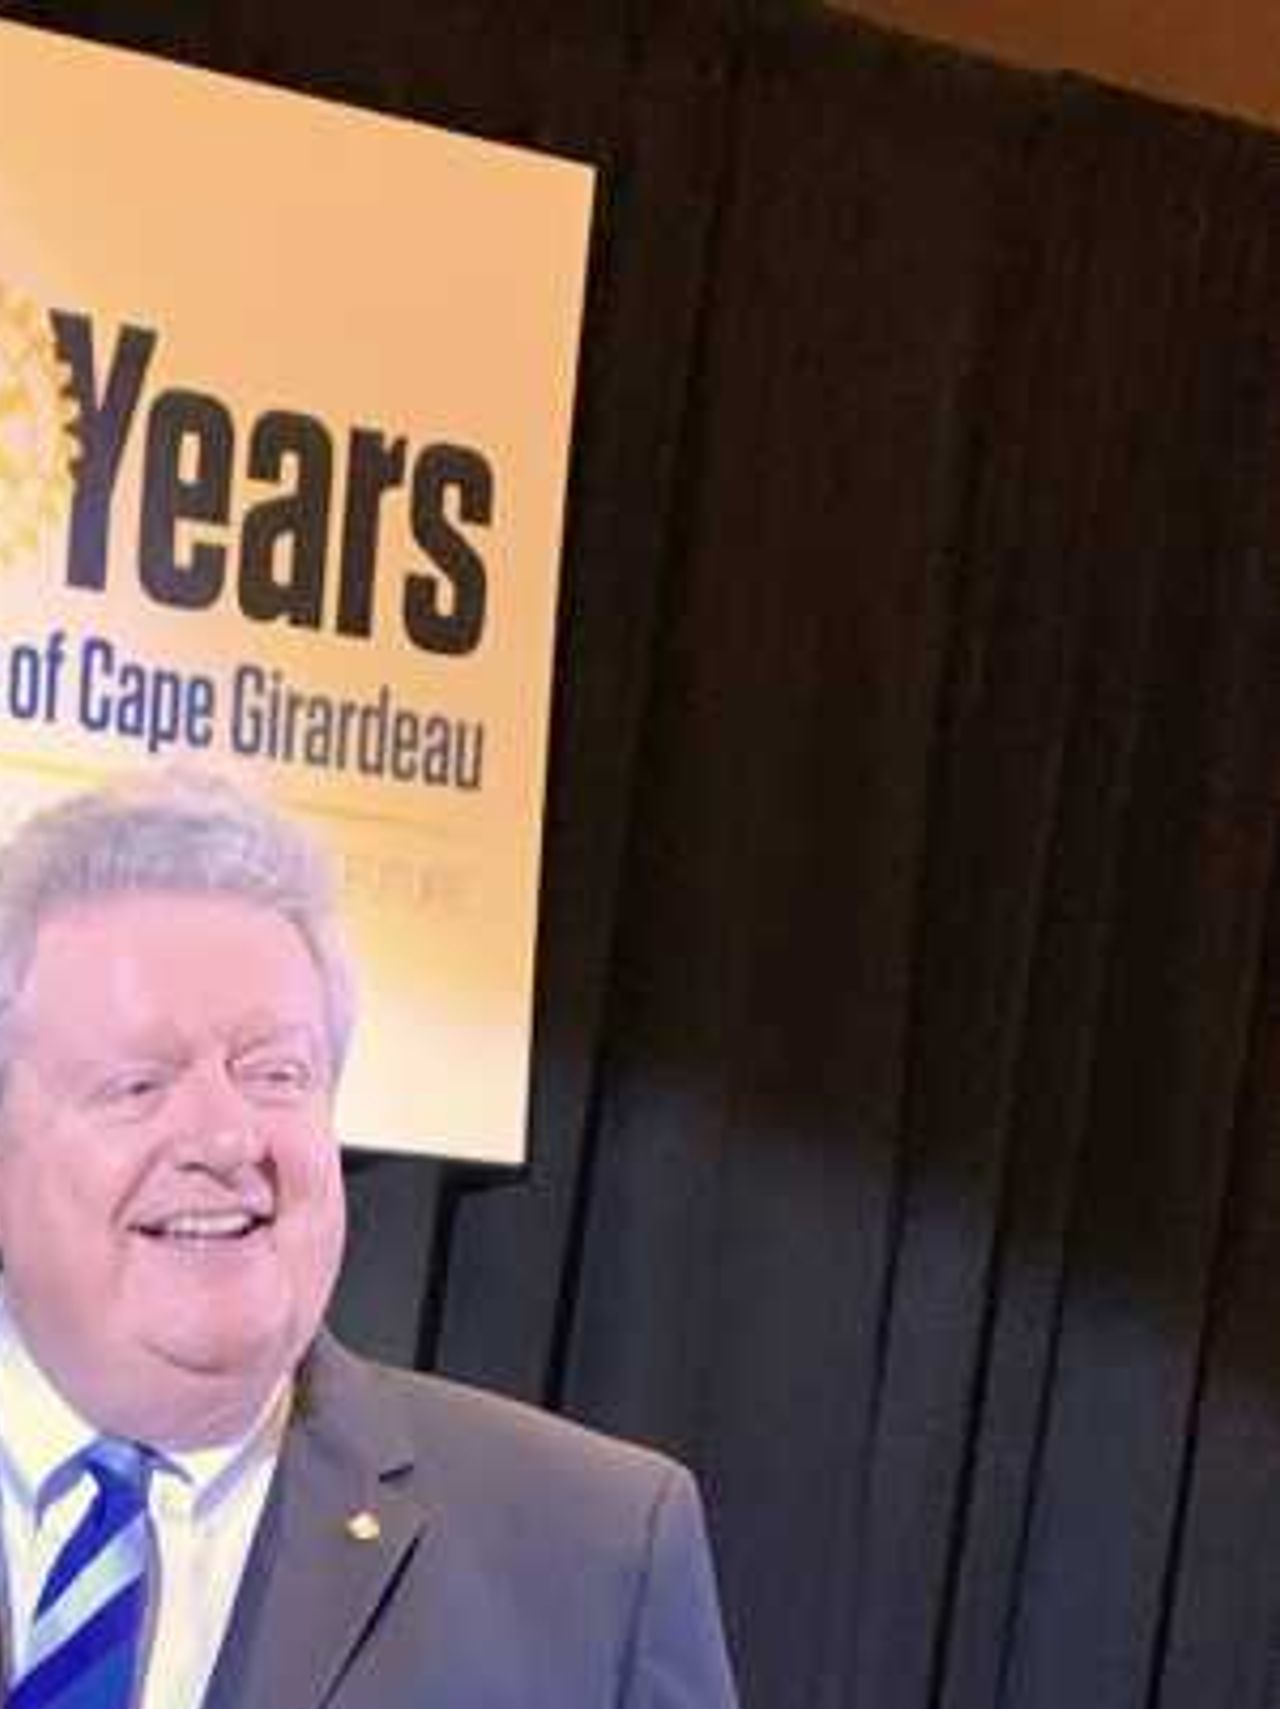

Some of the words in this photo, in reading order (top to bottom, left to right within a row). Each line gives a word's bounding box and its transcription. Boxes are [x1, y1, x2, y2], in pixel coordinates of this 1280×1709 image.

[49, 307, 495, 656] Years
[8, 630, 68, 724] of
[78, 636, 215, 753] Cape
[231, 664, 484, 791] Girardeau
